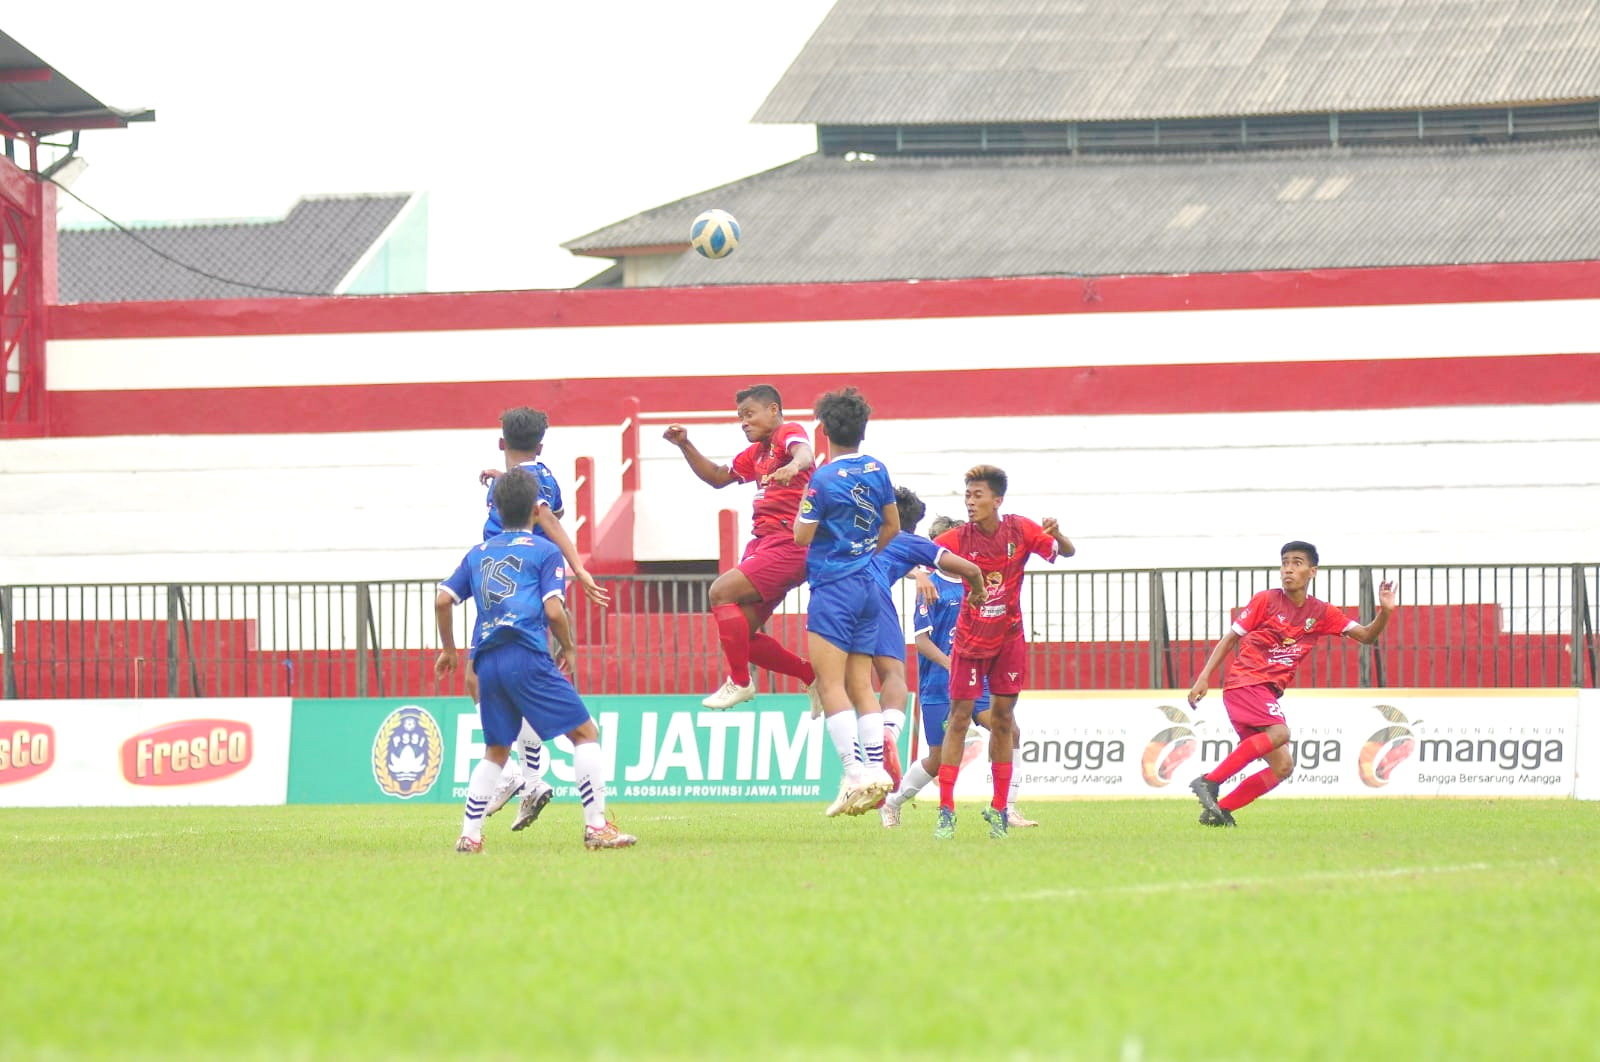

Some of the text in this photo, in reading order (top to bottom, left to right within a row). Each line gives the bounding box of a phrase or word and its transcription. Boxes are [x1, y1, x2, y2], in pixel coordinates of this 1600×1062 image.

[968, 668, 977, 686] 3
[1420, 727, 1495, 735] SARUNG
[392, 733, 425, 748] PSSI
[453, 711, 825, 783] PI JATIM
[0, 729, 48, 771] sCo
[136, 728, 246, 778] FresCo
[988, 740, 1125, 770] angga
[1419, 739, 1563, 770] mangga
[1025, 774, 1078, 784] Bersarung
[1081, 774, 1123, 784] Mangga
[1297, 774, 1340, 784] Mangga
[1418, 773, 1561, 784] Bangga Bersarung Mangga
[570, 786, 618, 797] INSIA
[624, 785, 681, 797] ASOSIASI
[684, 785, 742, 797] PROVINSI
[744, 785, 777, 797] JAWA
[780, 785, 820, 796] TIMUR
